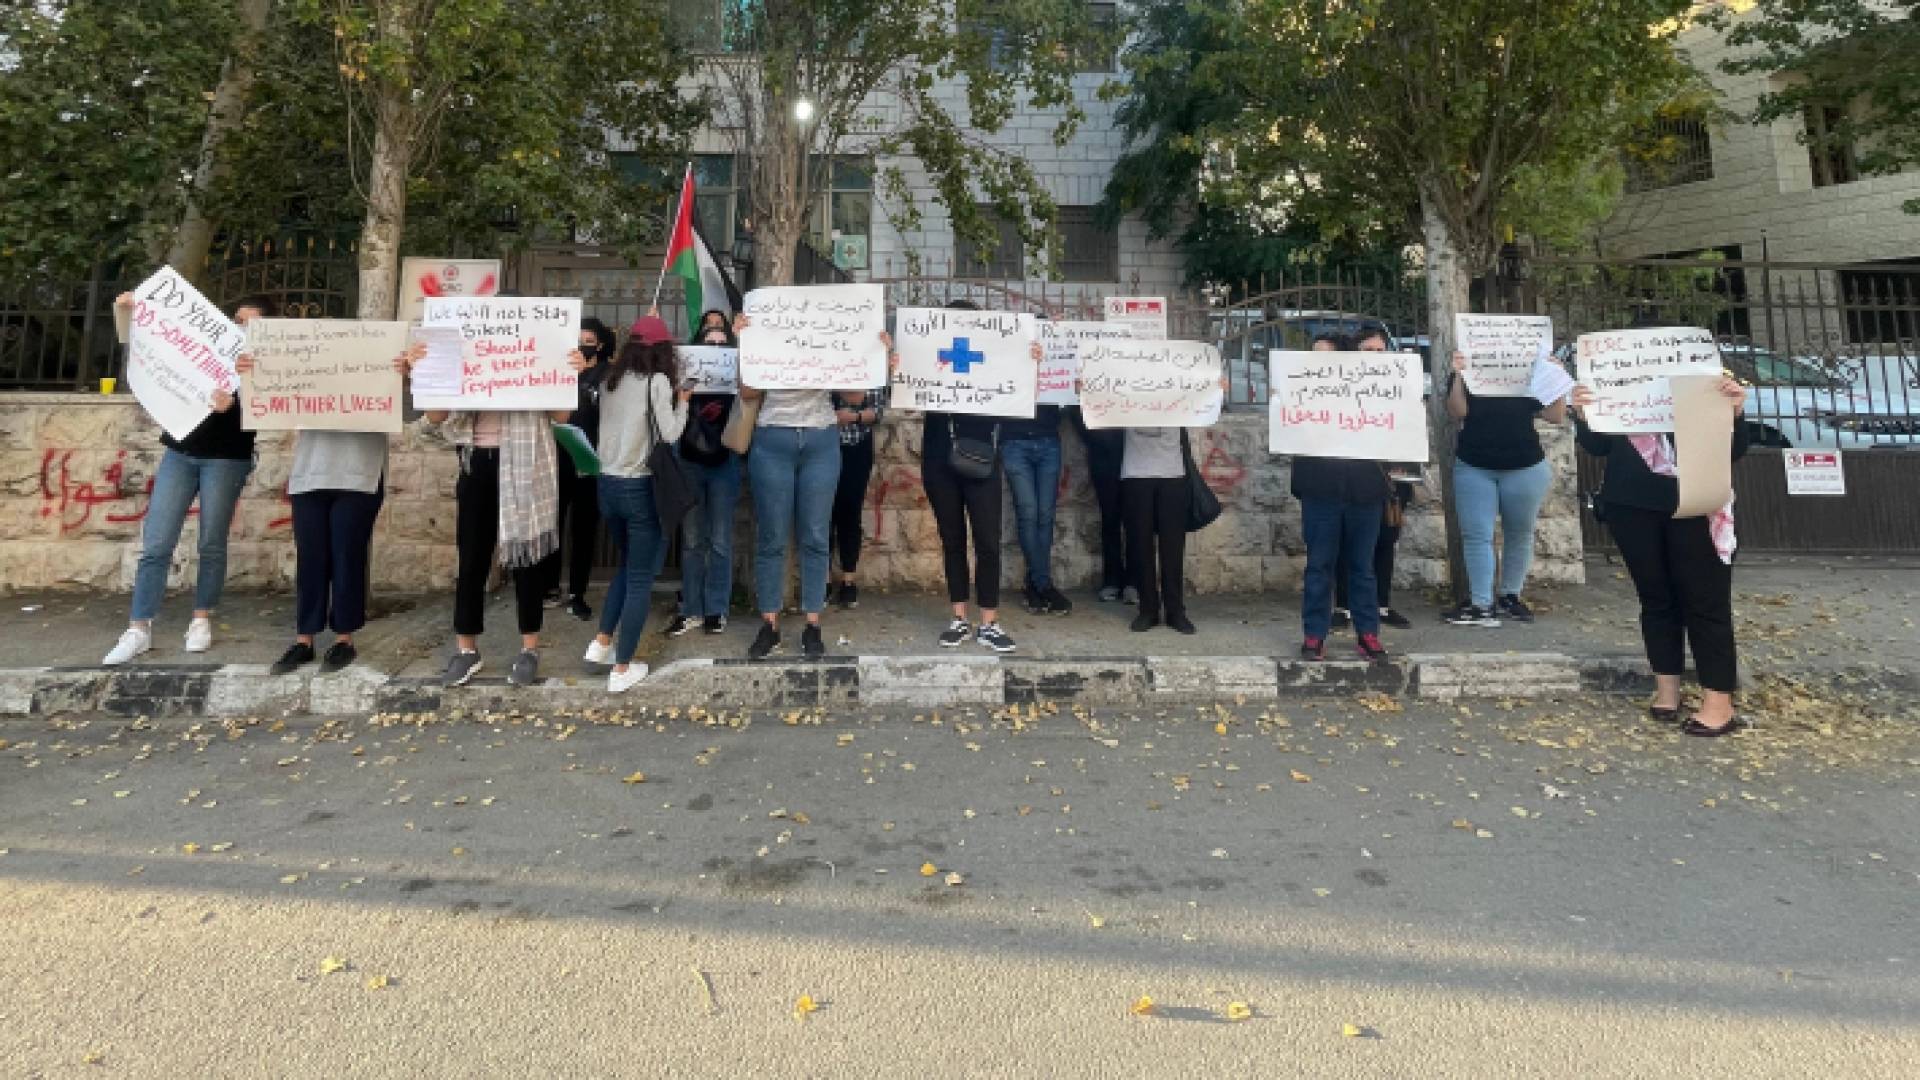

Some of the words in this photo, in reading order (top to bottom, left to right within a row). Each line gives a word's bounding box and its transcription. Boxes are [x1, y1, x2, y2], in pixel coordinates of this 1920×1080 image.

[146, 277, 185, 309] DO
[181, 301, 228, 344] YOUR
[496, 305, 528, 320] not
[475, 337, 536, 357] Should
